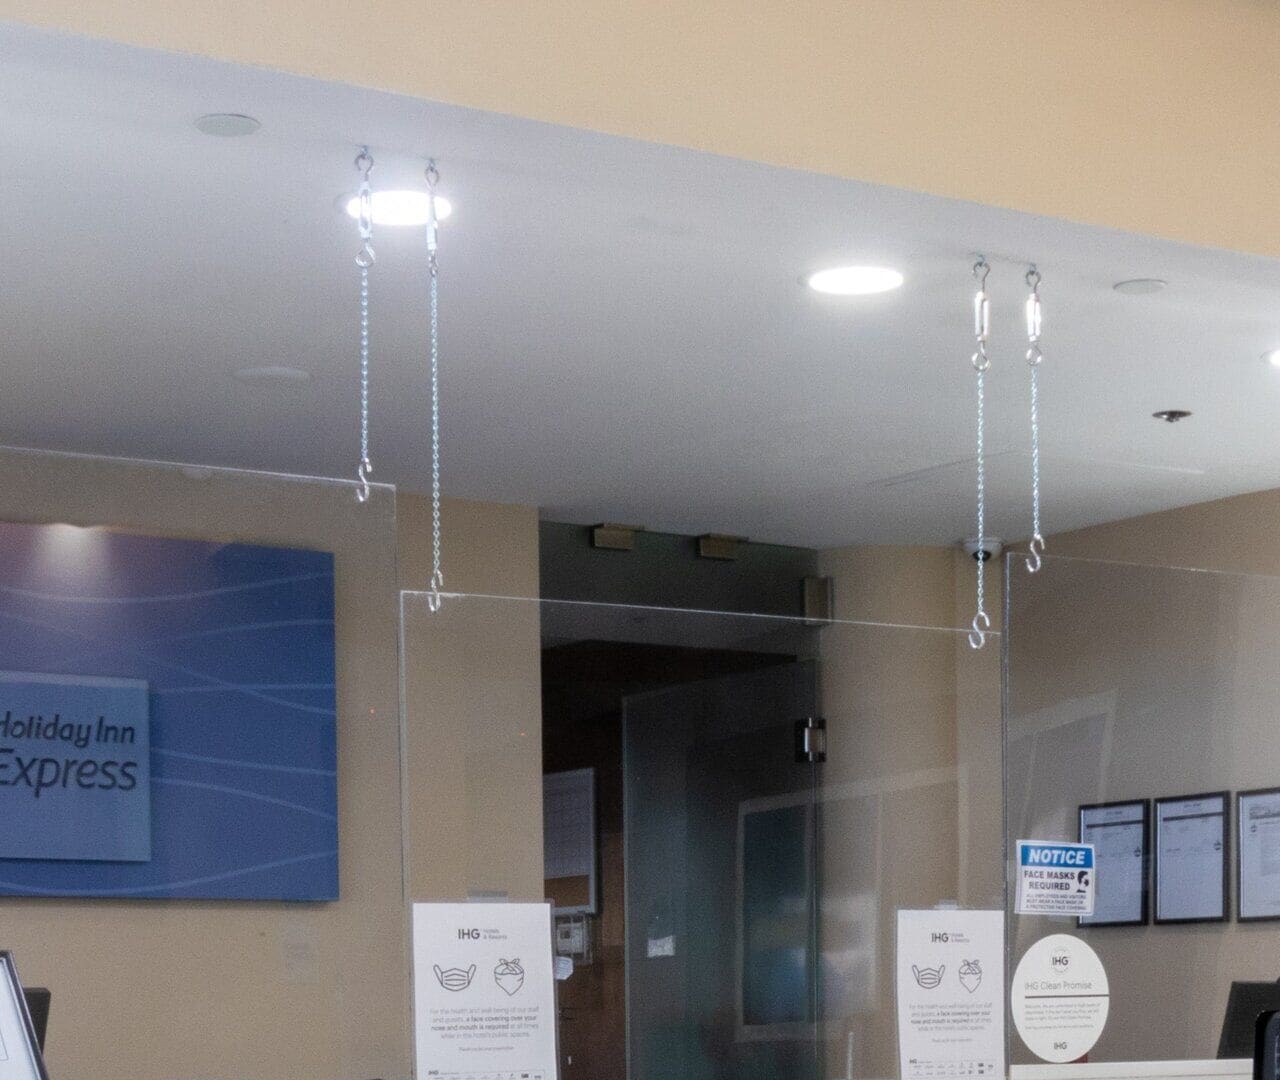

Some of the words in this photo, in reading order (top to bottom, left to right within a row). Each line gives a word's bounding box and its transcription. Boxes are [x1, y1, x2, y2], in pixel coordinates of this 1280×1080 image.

[96, 717, 135, 743] Inn
[1029, 849, 1086, 865] NOTICE
[1024, 870, 1044, 878] FACE
[1047, 871, 1075, 880] MASKS
[1029, 882, 1070, 890] REQUIRED
[458, 928, 480, 940] IHG
[931, 932, 949, 943] IHG
[1052, 956, 1069, 966] IHG
